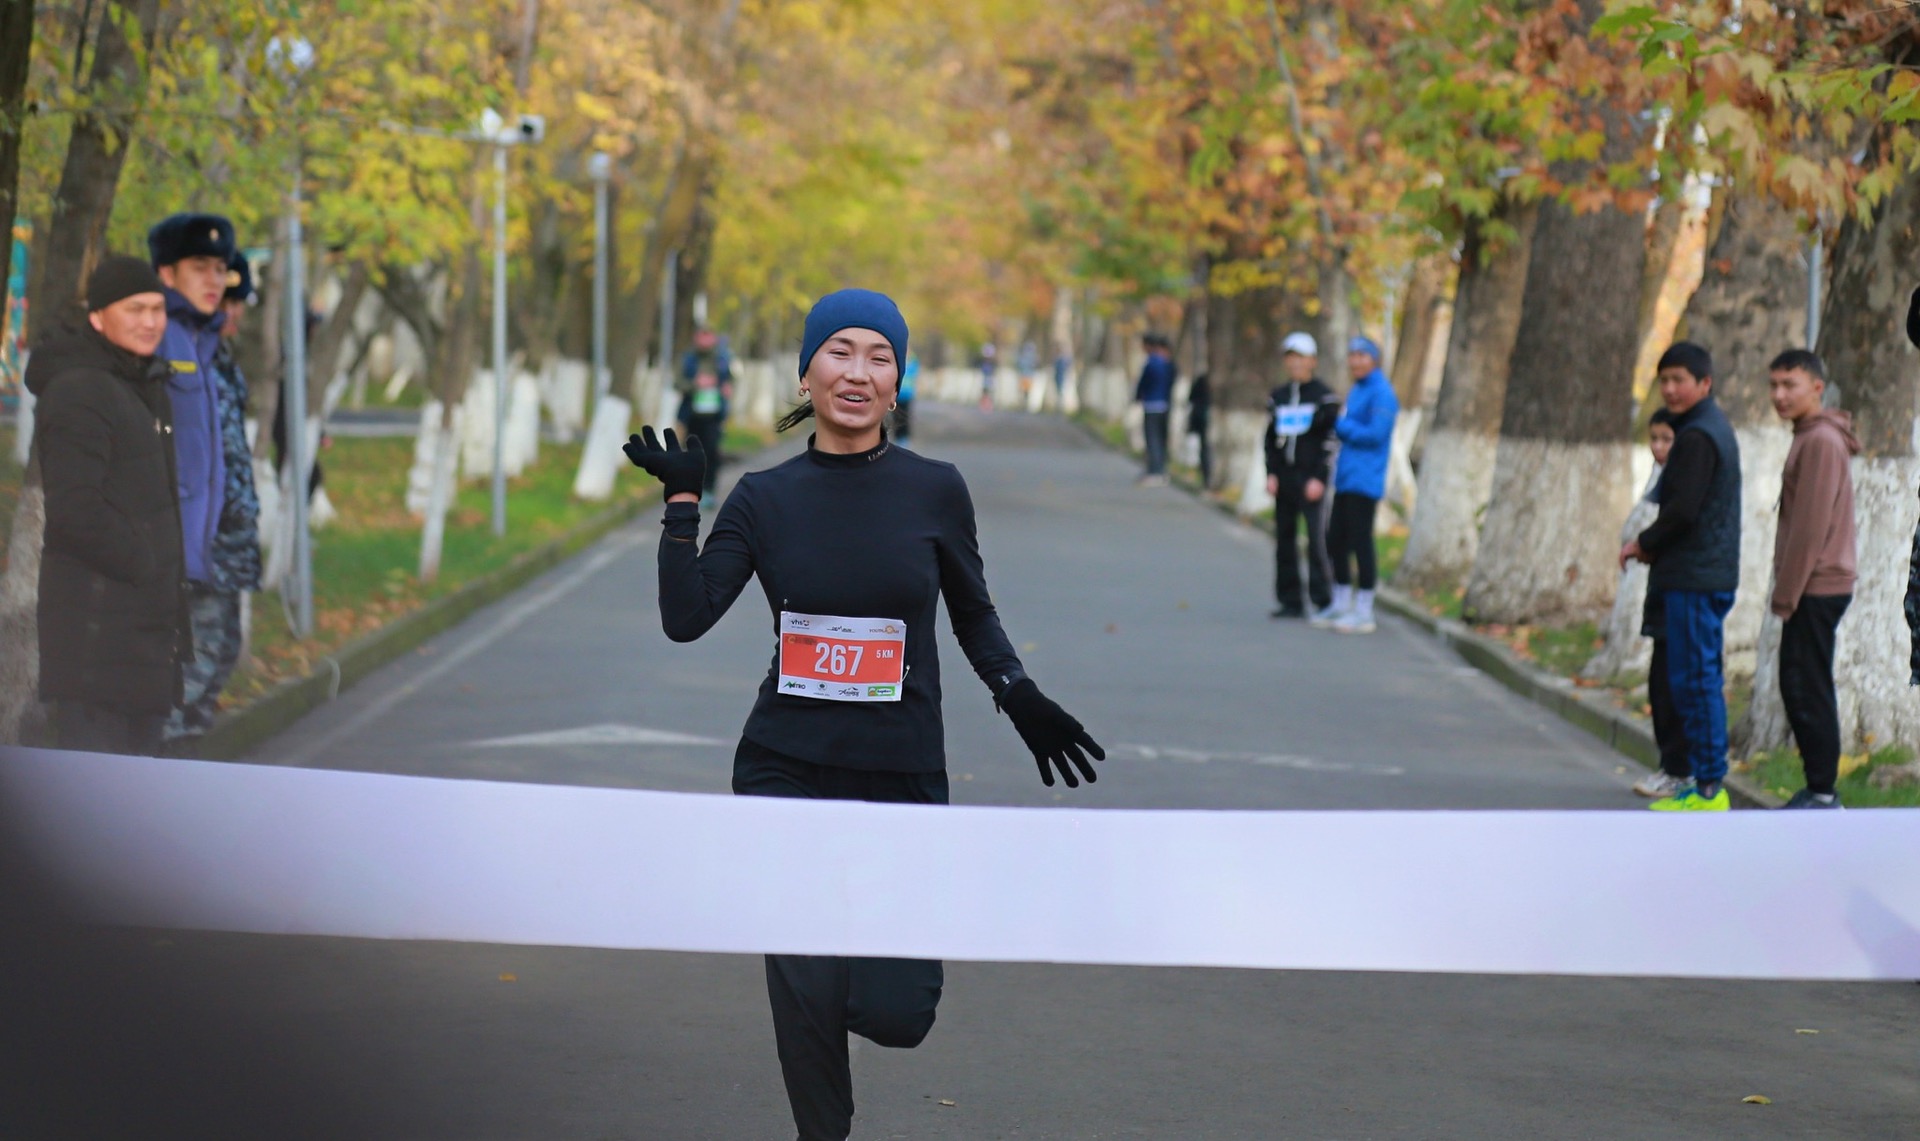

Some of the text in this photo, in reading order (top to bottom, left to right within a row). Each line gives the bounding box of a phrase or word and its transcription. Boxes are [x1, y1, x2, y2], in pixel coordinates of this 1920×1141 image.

[814, 642, 864, 676] 267
[876, 649, 894, 659] 5 KM
